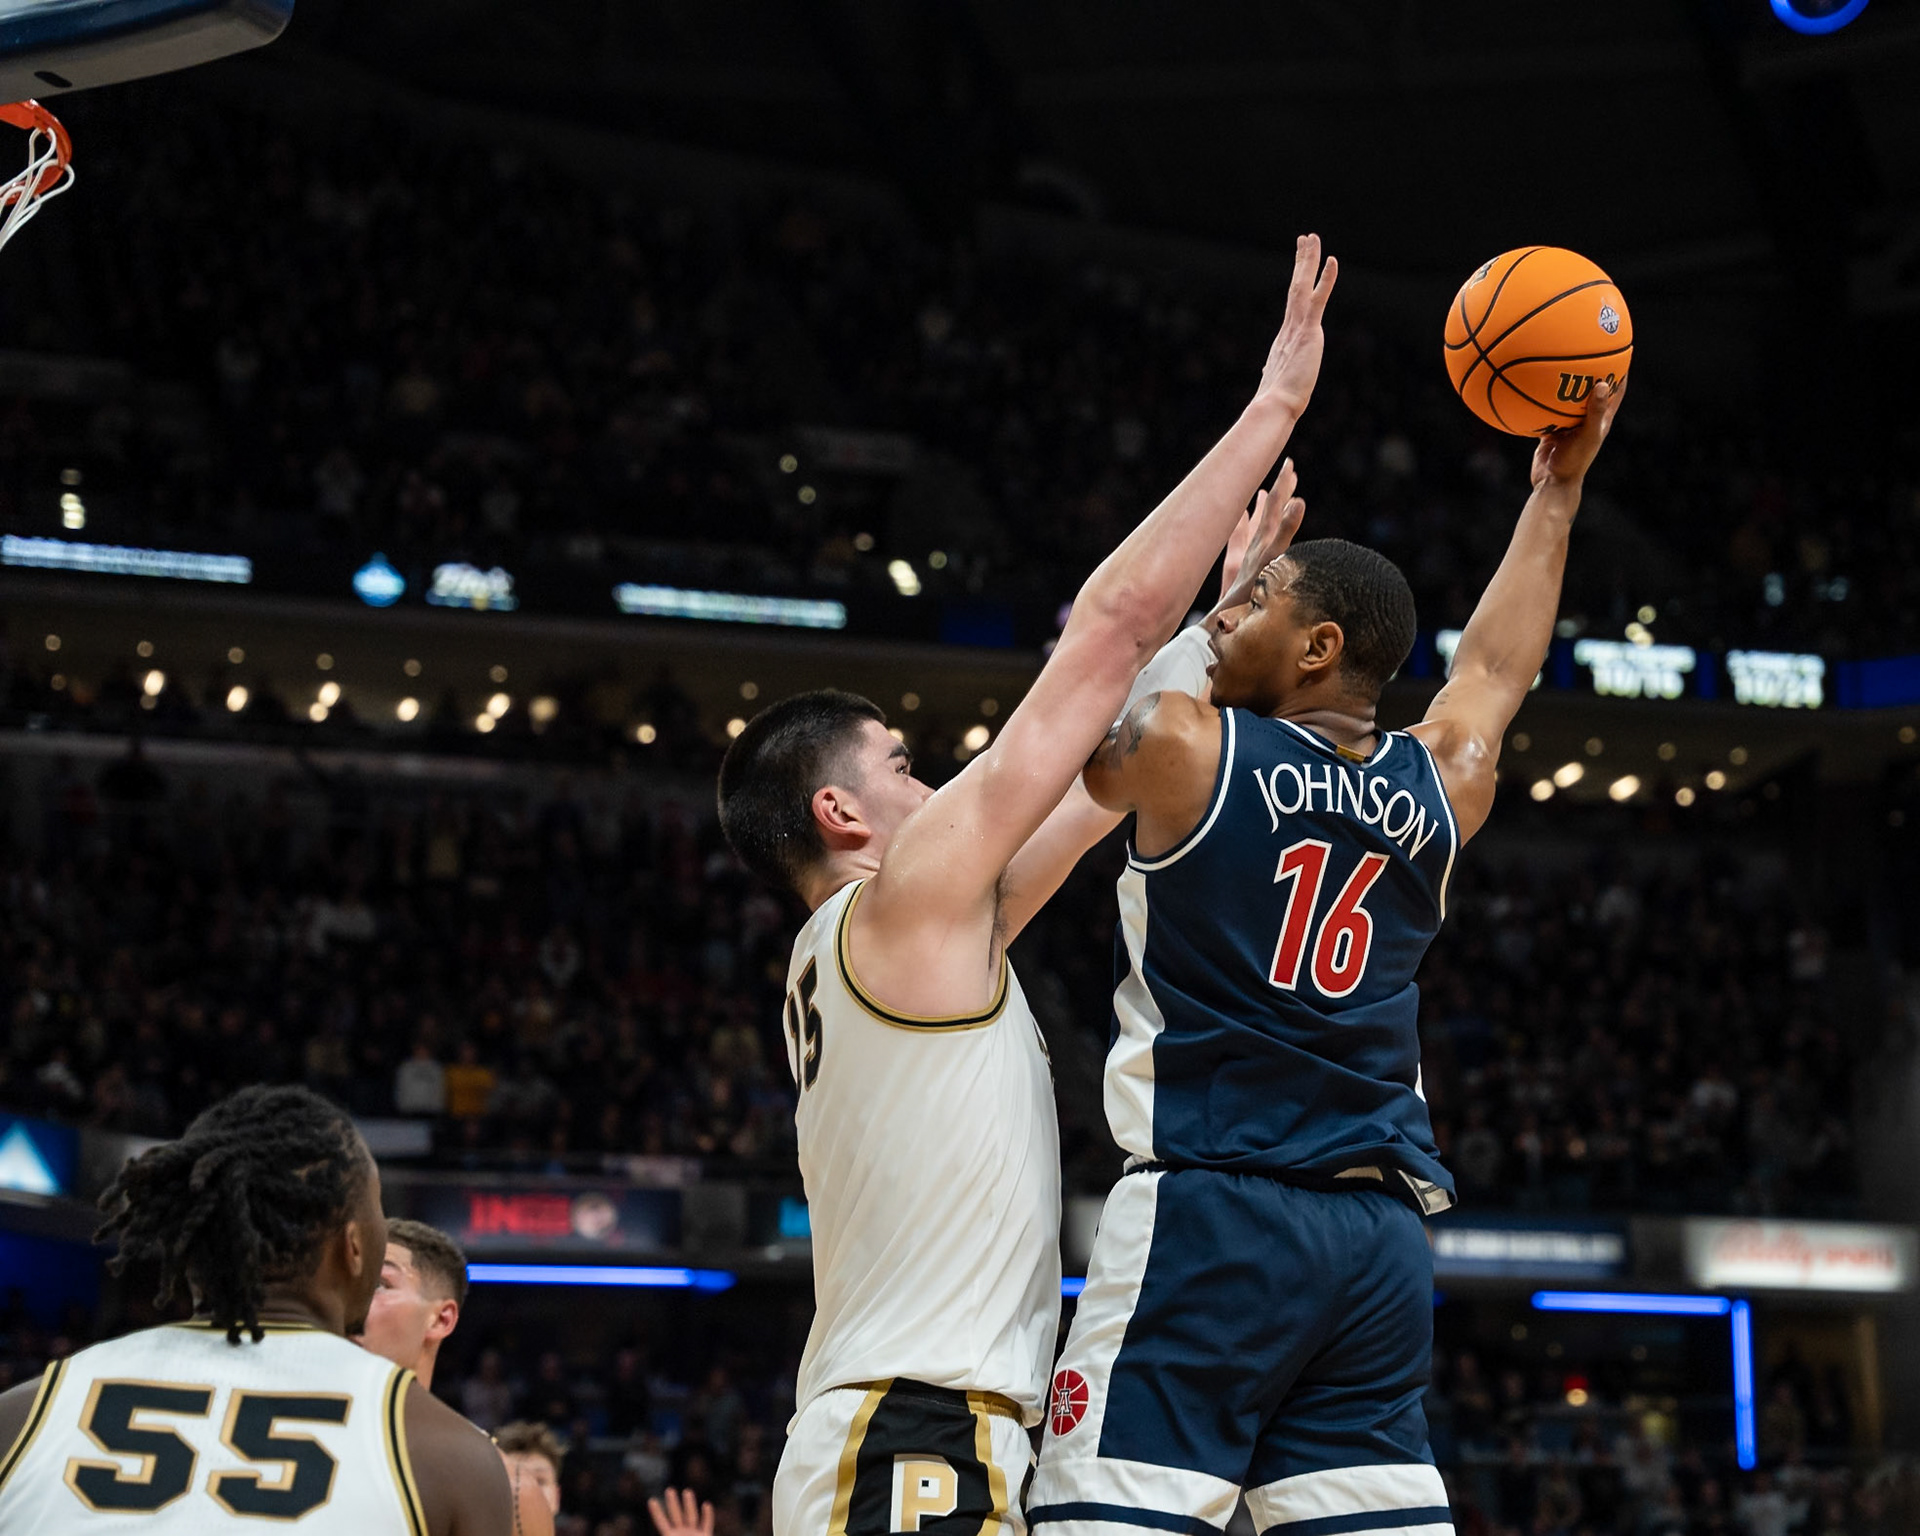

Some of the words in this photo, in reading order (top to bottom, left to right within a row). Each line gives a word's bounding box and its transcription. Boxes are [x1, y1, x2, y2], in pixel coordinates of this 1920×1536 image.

[1253, 762, 1439, 861] JOHNSON
[1268, 838, 1390, 998] 16
[787, 955, 823, 1094] 15
[63, 1378, 352, 1520] 55
[1056, 1389, 1072, 1415] A
[890, 1453, 958, 1532] P
